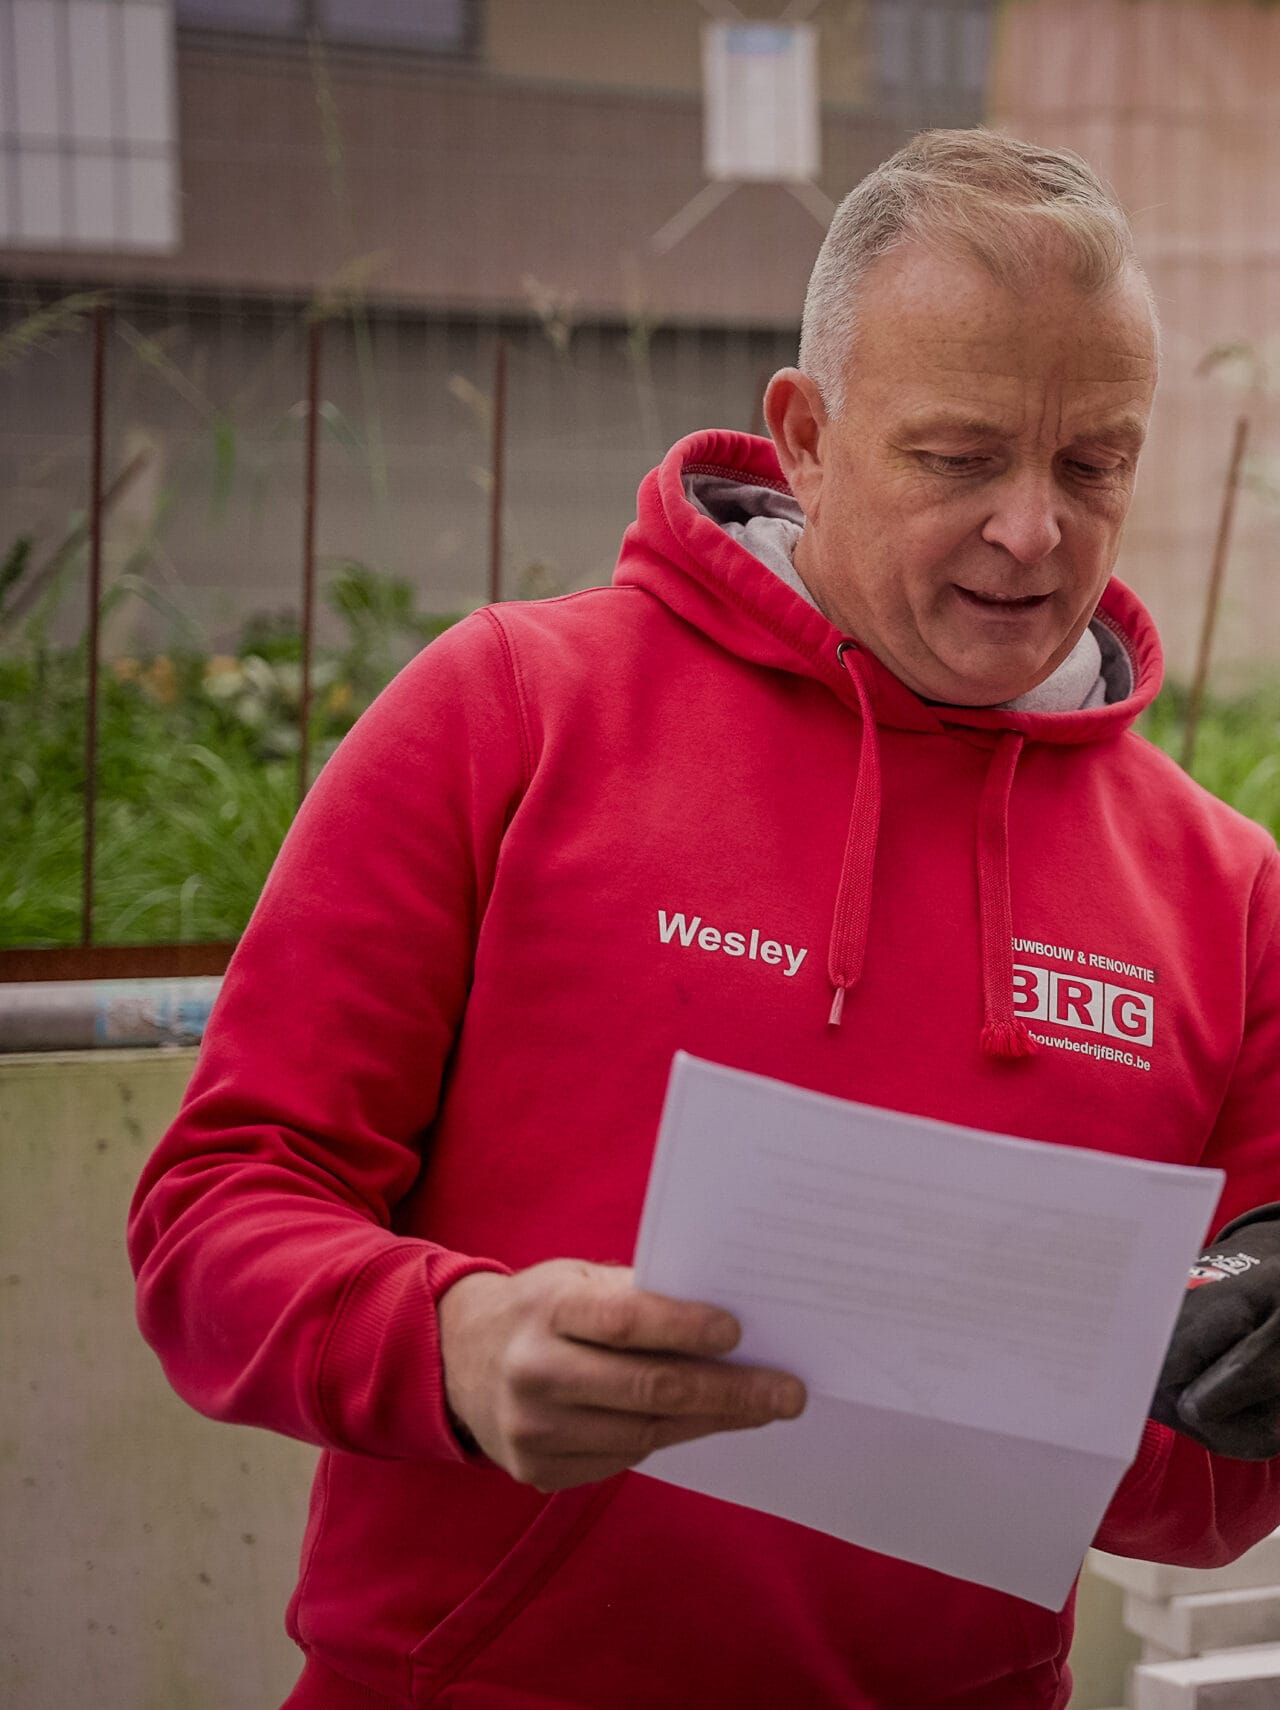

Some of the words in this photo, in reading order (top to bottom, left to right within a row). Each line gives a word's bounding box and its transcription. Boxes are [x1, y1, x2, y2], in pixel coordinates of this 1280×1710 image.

[657, 910, 808, 977] Wesley
[1011, 937, 1075, 962] UWBOUW
[1077, 951, 1087, 965] &
[1089, 953, 1155, 983] RENOVATIE
[1013, 968, 1148, 1038] BRG
[1028, 1030, 1151, 1071] ouwbedrijfBRG.be
